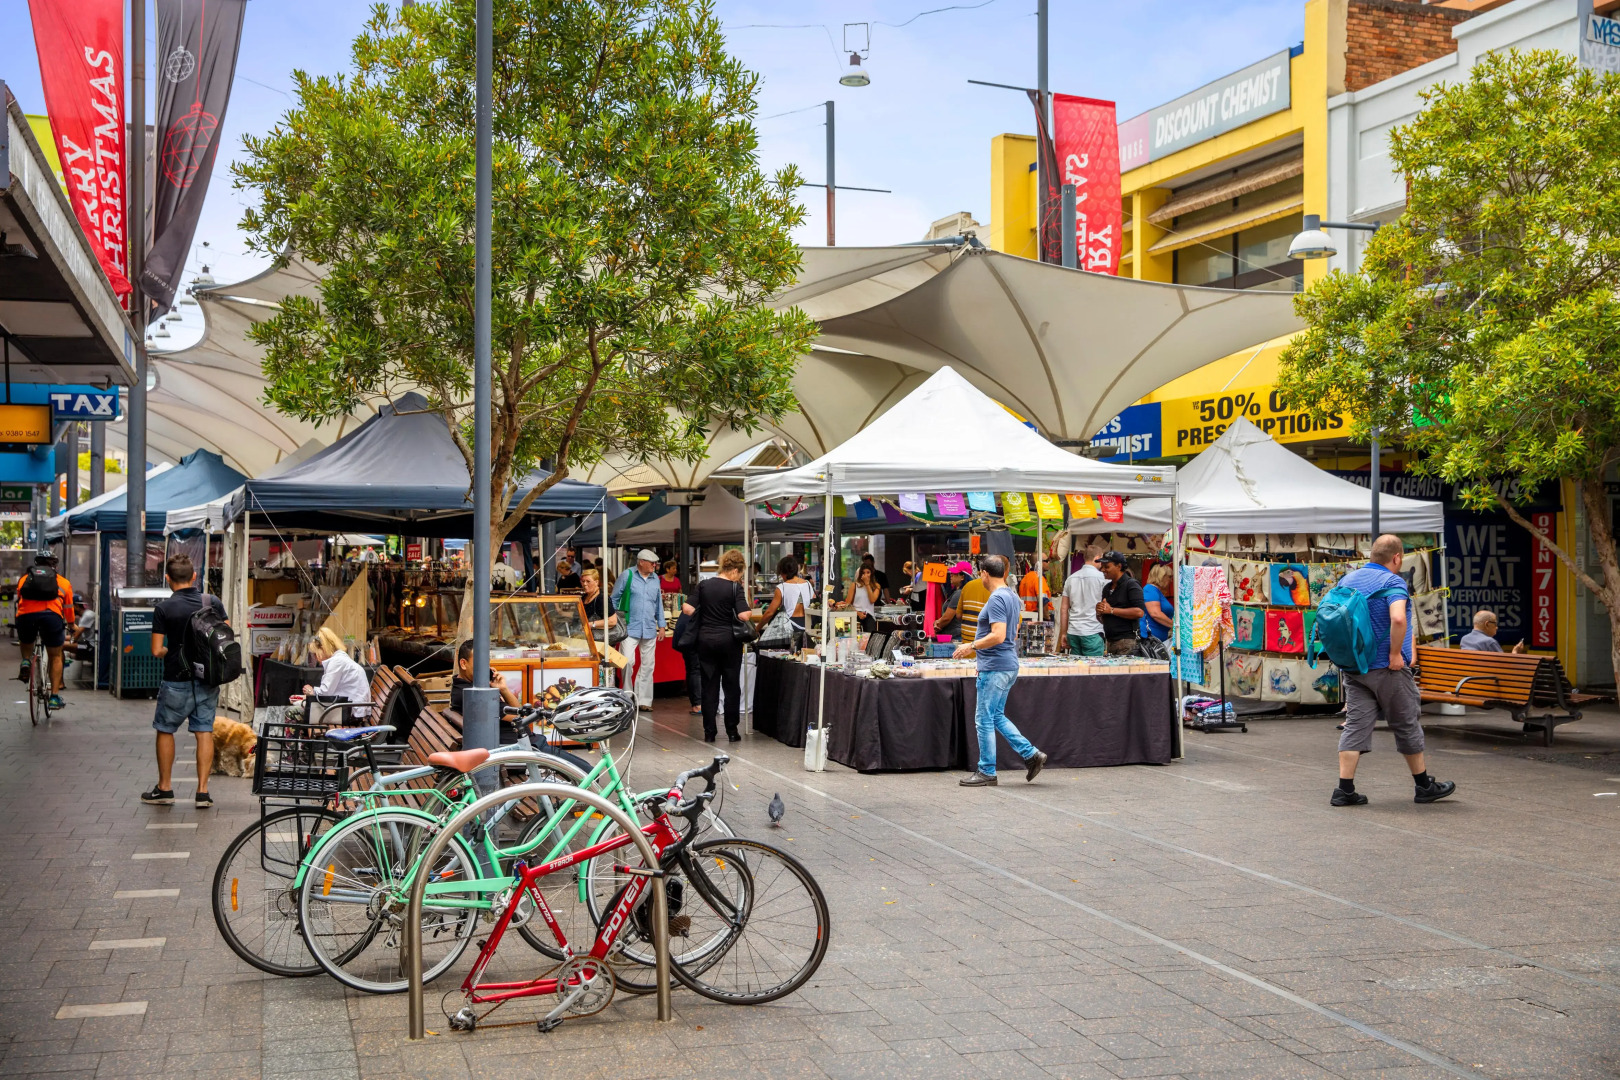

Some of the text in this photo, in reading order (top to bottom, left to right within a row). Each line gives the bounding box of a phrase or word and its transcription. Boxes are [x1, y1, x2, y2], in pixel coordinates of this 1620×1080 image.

[1155, 66, 1282, 149] DISCOUNT CHEMIST
[84, 46, 125, 303] HRISTMAS
[50, 393, 115, 416] TAX
[1200, 392, 1261, 422] 50%
[6, 430, 40, 438] 9389 1547
[1177, 410, 1344, 448] PRESIPTIONS
[1393, 476, 1443, 497] CHEMIST
[1456, 524, 1507, 556] WE
[1445, 556, 1521, 588] BEAT
[1536, 515, 1553, 644] OPEN 7 DAYS
[1447, 588, 1521, 603] VERYONE'S
[253, 612, 291, 620] MULBERRY
[530, 886, 555, 924] POTENZA
